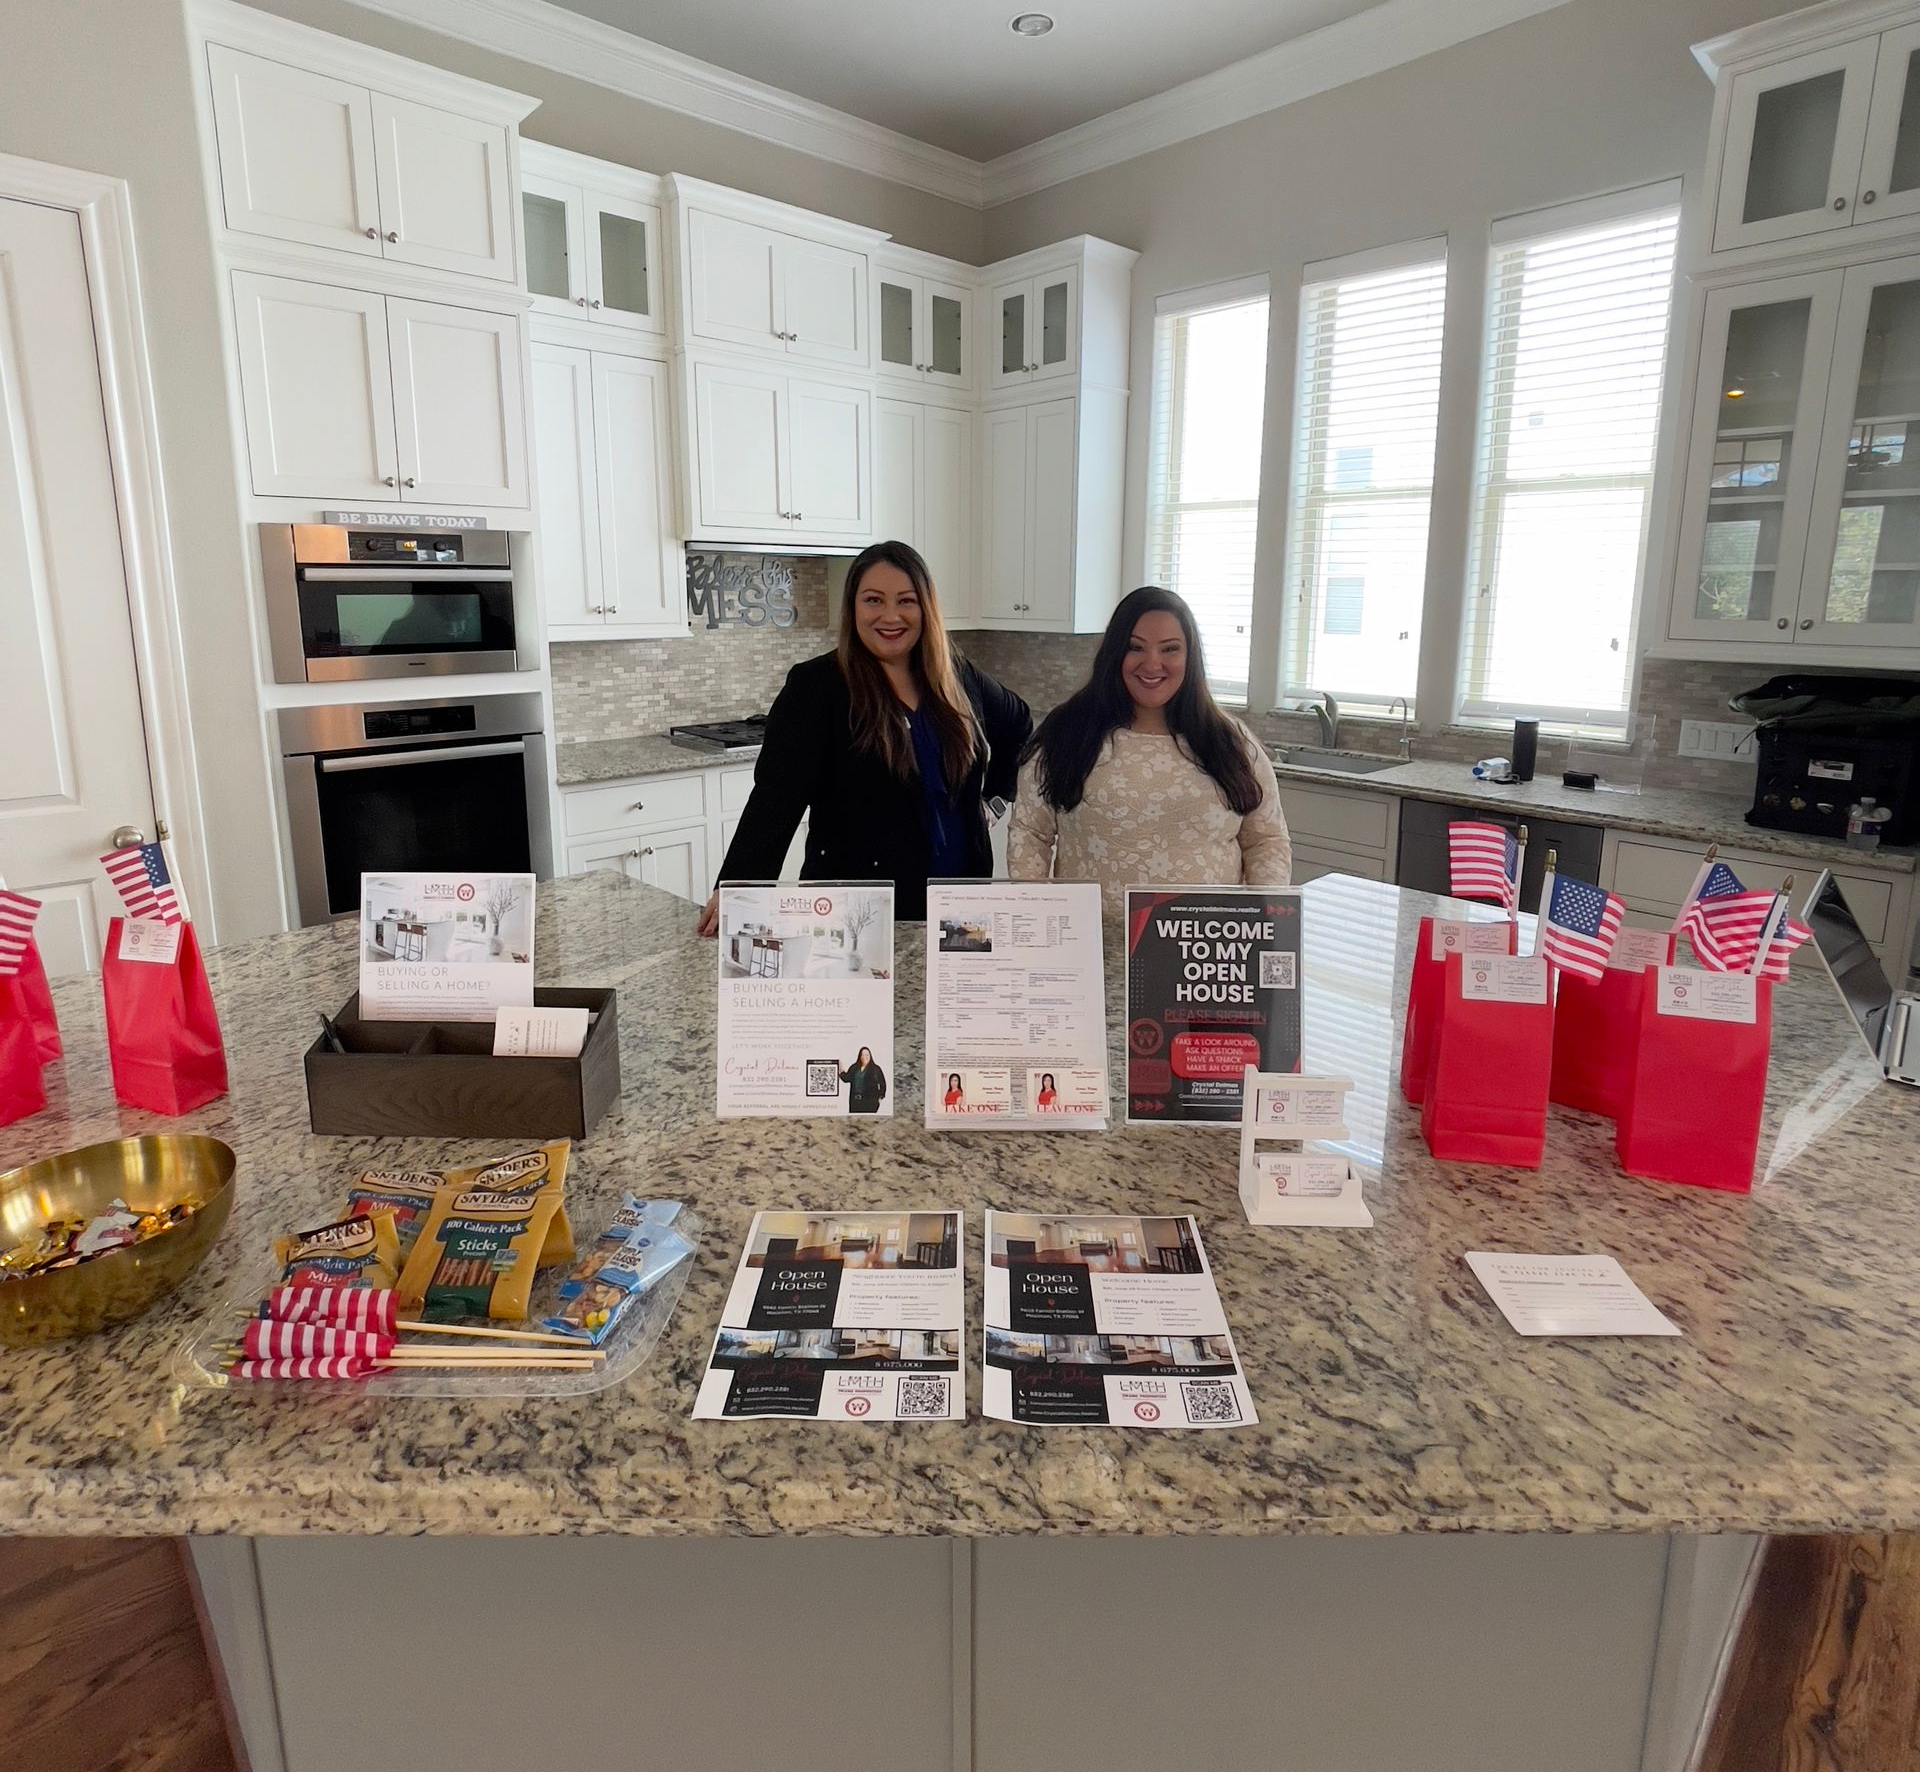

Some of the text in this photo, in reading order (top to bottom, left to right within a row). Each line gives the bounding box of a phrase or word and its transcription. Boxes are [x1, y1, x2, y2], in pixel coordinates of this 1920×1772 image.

[337, 512, 477, 528] BE BRAVE TODAY
[686, 555, 797, 590] Bless this
[687, 582, 798, 630] MESS
[1156, 919, 1275, 940] WELCOME
[1178, 941, 1253, 960] TO MY
[377, 966, 449, 977] BUYING OR
[1183, 962, 1247, 982] OPEN
[377, 980, 492, 991] SELLING A HOME?
[733, 983, 806, 994] BUYING OR
[1176, 983, 1255, 1003] HOUSE
[732, 997, 851, 1008] SELLING A HOME?
[1164, 1008, 1210, 1021] PLEASE
[1215, 1010, 1253, 1021] SIGN
[1202, 1038, 1222, 1046] LOOK
[1223, 1039, 1257, 1047] AROUND
[1201, 1047, 1244, 1055] QUESTIONS
[1215, 1056, 1242, 1064] SNACK
[1186, 1064, 1207, 1072] MAKE
[944, 1104, 1001, 1113] TAKE ONE
[1036, 1104, 1096, 1113] LEAVE ONE
[446, 1221, 522, 1234] 100 Calorie Pack
[457, 1239, 499, 1251] Sticks
[778, 1270, 825, 1281] Open
[1026, 1273, 1074, 1284] Open
[771, 1280, 828, 1291] House
[1022, 1284, 1079, 1295] House
[838, 1375, 884, 1388] LMTH
[1119, 1381, 1167, 1393] LMTH
